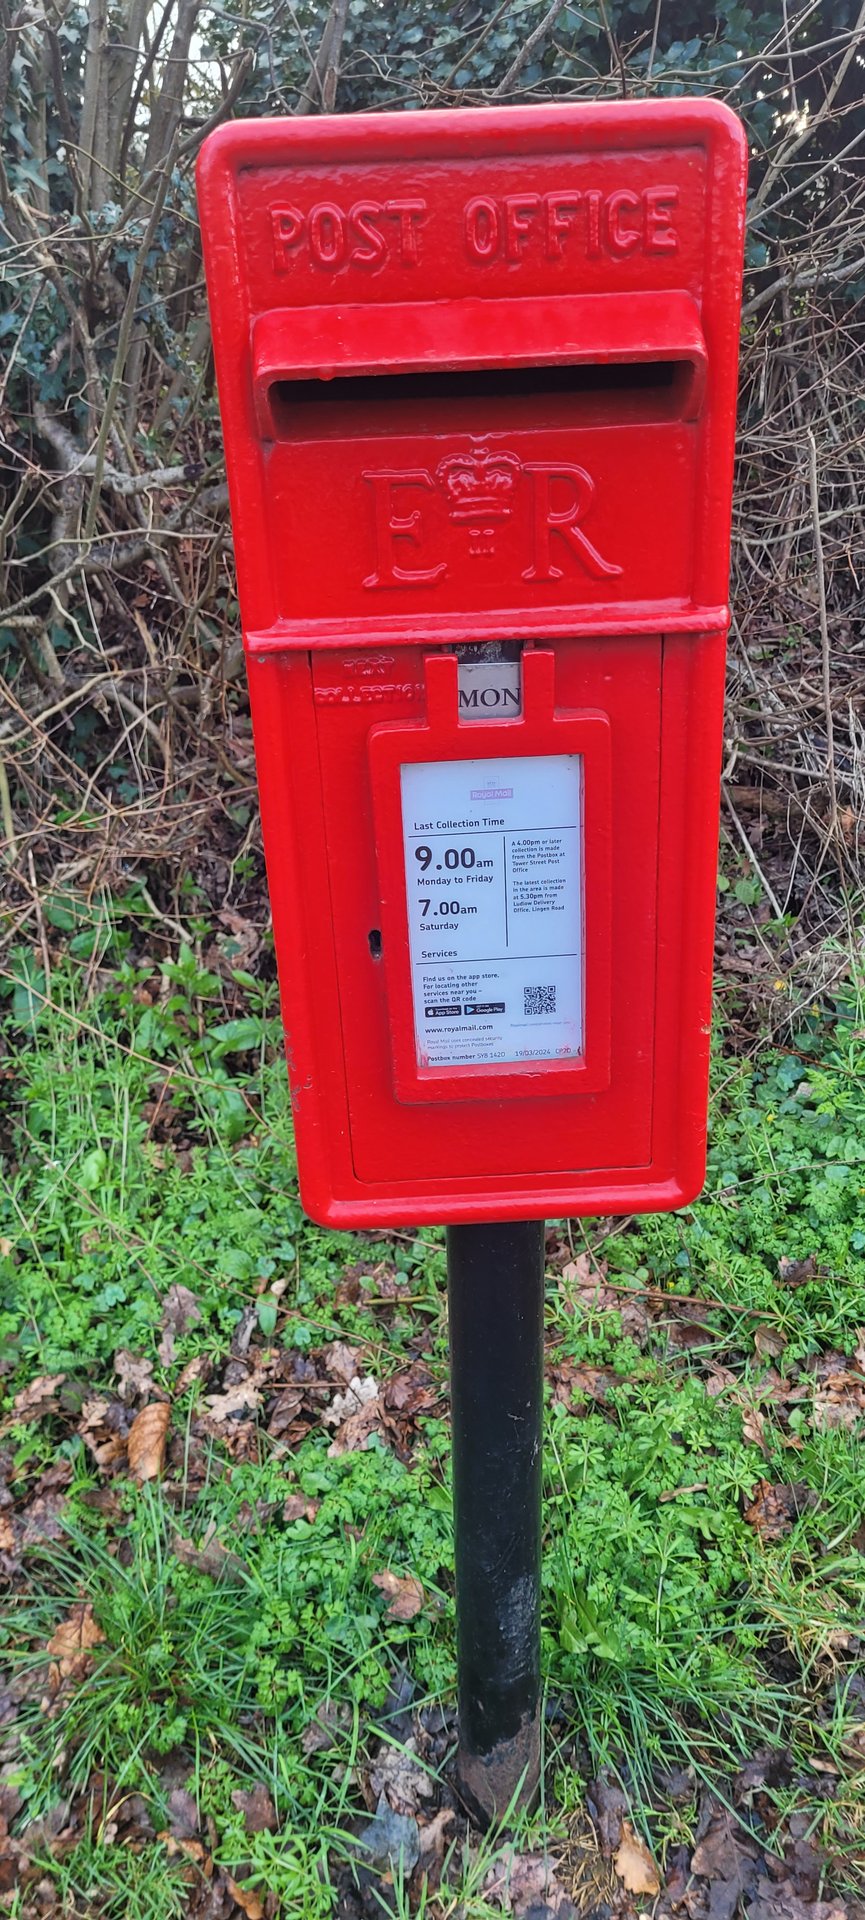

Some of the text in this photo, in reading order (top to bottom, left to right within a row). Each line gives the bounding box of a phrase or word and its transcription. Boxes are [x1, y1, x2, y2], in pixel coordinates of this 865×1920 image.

[268, 184, 680, 273] POST OFFICE
[458, 687, 521, 708] MON
[472, 789, 512, 800] Royal Mail
[414, 818, 505, 830] Last Collection Time
[415, 846, 494, 871] 9.00am
[418, 878, 452, 886] Monday
[466, 874, 494, 883] Friday
[418, 899, 478, 916] 7.00am
[420, 922, 458, 931] Saturday
[422, 949, 458, 958] Services
[425, 1024, 494, 1034] www.royalmail.com
[514, 1048, 550, 1057] 19/03/2024
